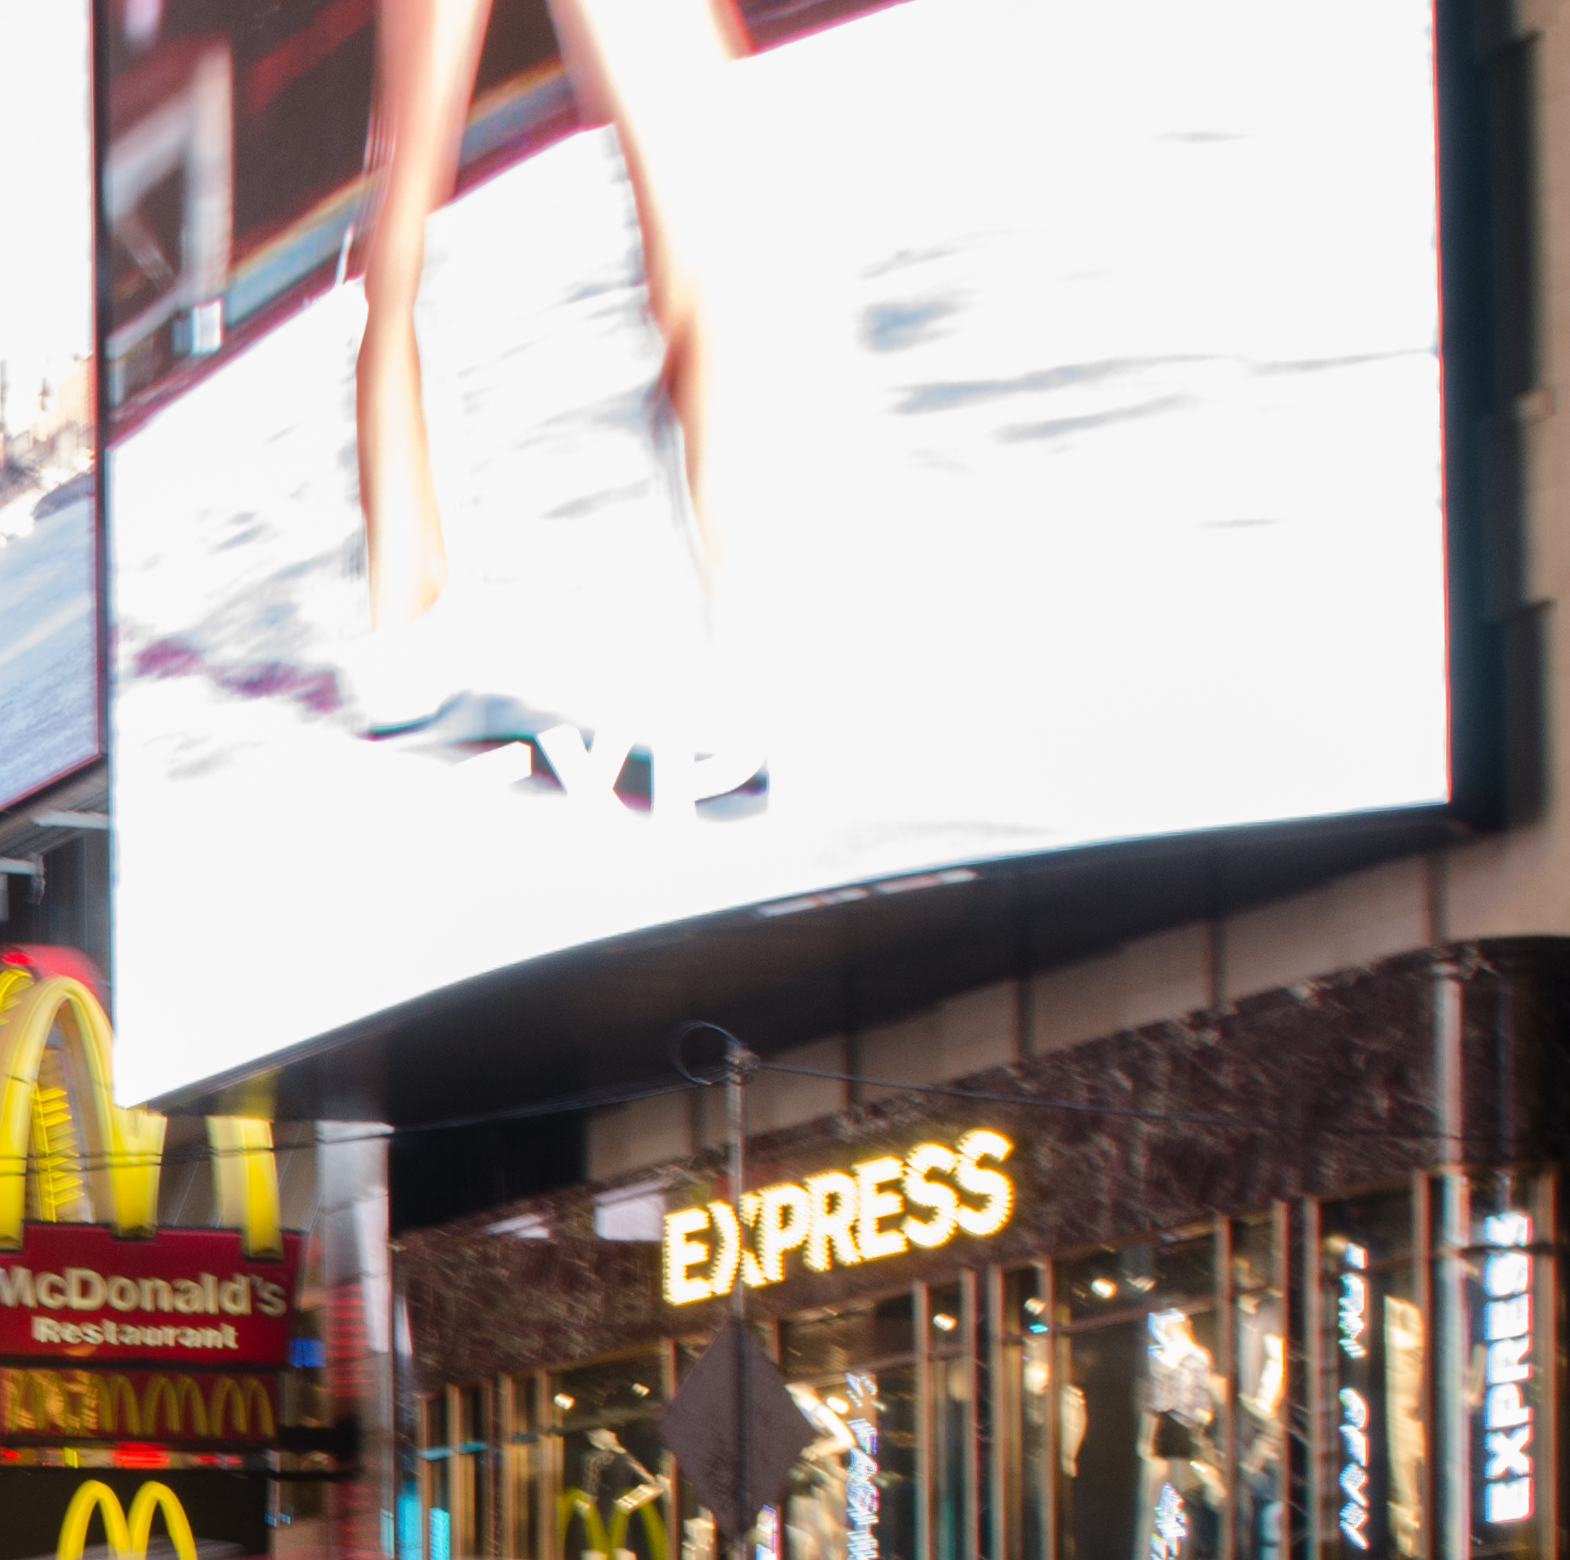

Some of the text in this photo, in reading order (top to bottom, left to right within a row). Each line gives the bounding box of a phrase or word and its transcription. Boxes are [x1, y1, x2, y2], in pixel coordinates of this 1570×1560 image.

[662, 1127, 1015, 1307] EXPRESS
[30, 1314, 239, 1350] Restaurant
[1484, 1211, 1534, 1523] EXPRESS
